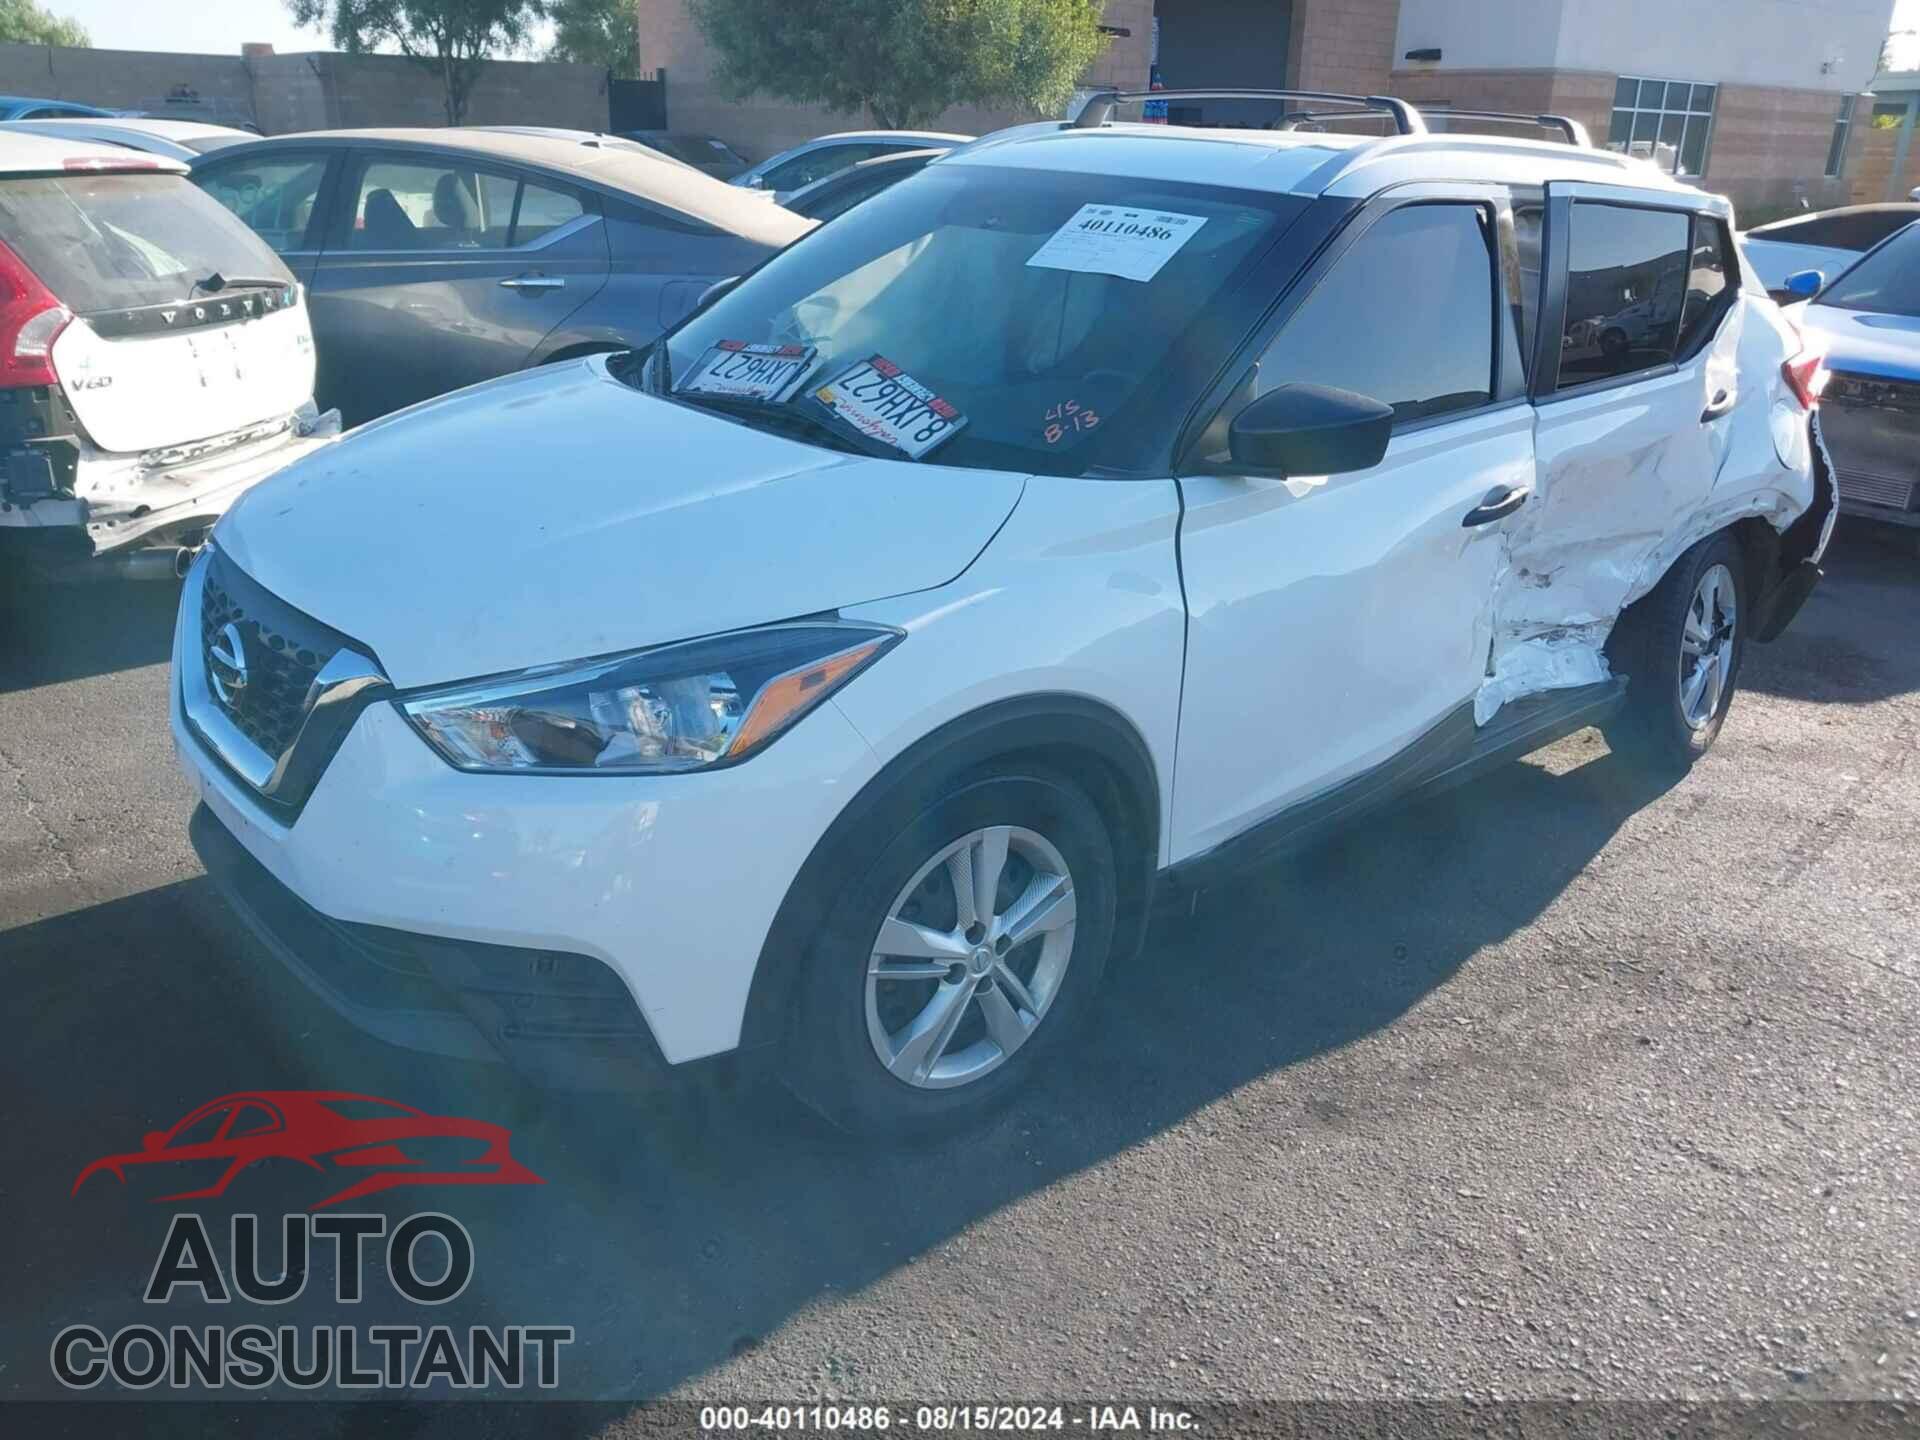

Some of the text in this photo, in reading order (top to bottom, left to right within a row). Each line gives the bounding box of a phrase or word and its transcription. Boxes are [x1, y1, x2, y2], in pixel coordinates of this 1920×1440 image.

[1077, 218, 1173, 241] 40110486
[161, 295, 273, 324] VOLVO
[838, 366, 948, 443] 8JXH627
[1044, 410, 1100, 444] 8-13
